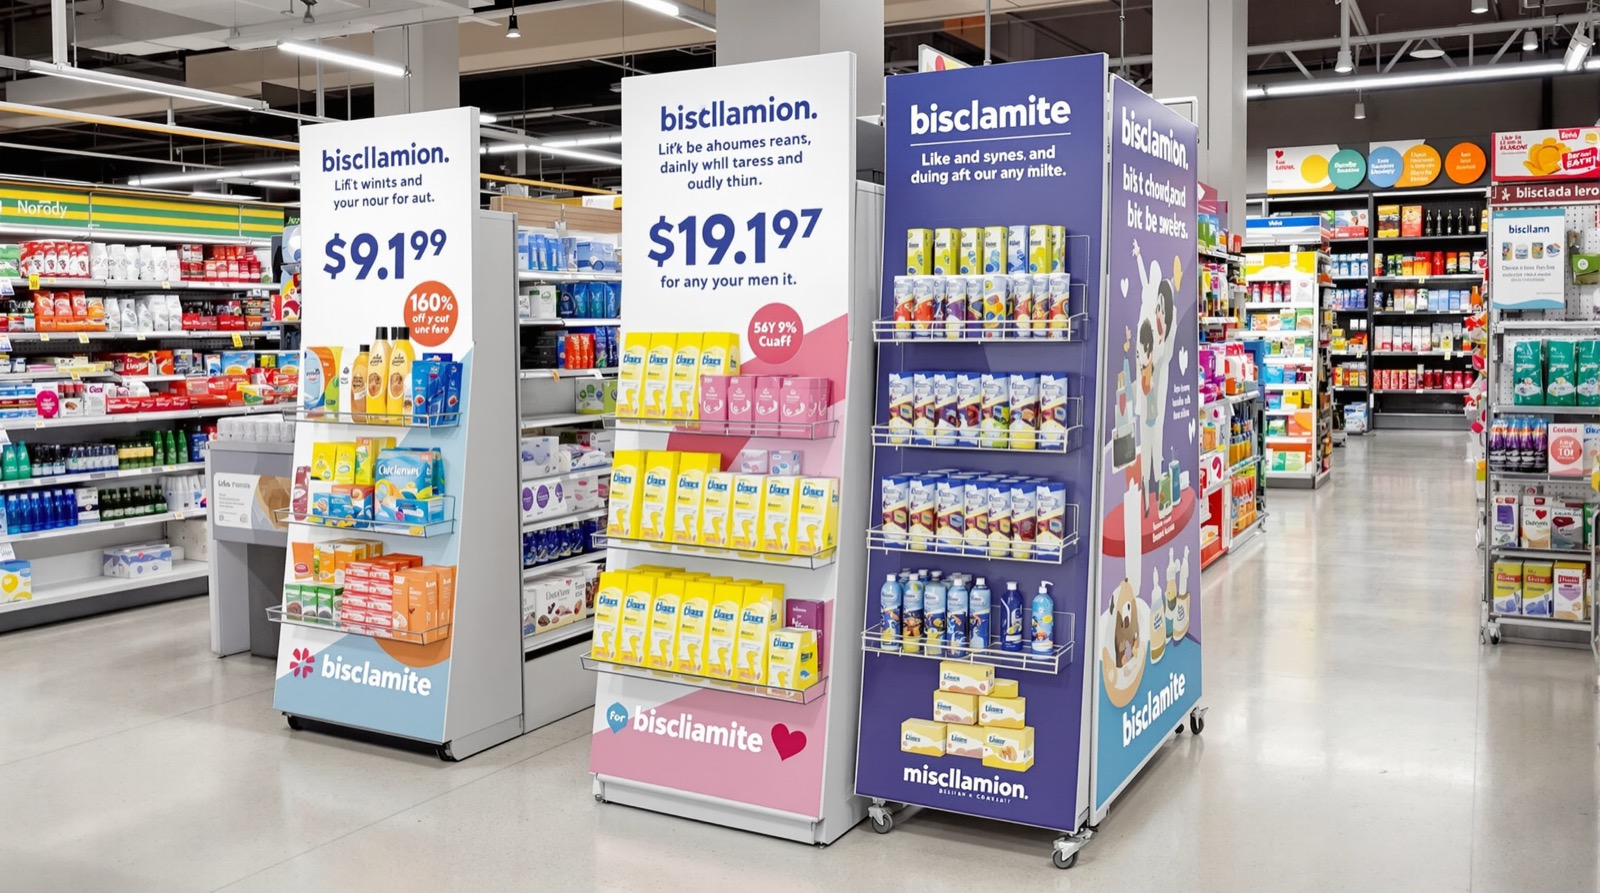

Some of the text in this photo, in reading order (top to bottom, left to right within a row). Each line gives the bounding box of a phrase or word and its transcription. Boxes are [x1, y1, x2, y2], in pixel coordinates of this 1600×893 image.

[911, 94, 1071, 135] bisclamite
[686, 141, 703, 153] be
[706, 136, 766, 152] ahoumes
[769, 133, 812, 149] reans,
[1121, 106, 1189, 171] bisclamion.
[323, 141, 450, 173] biscllamion.
[660, 159, 699, 176] dainly
[733, 154, 774, 169] taress
[778, 151, 803, 166] and
[922, 151, 950, 166] Like
[954, 149, 980, 164] and
[1029, 145, 1056, 160] and
[400, 174, 422, 187] and
[687, 176, 723, 191] oudly
[910, 170, 948, 185] duing
[974, 168, 997, 180] our
[1000, 167, 1024, 181] any
[333, 192, 435, 211] your nour for aut.
[1516, 186, 1571, 199] blisclada
[1145, 205, 1157, 234] be
[647, 207, 823, 268] $19.197
[323, 228, 447, 281] $9.199
[661, 272, 797, 290] for any your men it.
[410, 292, 453, 312] 160%
[412, 313, 426, 324] off
[778, 320, 797, 334] 9%
[321, 653, 432, 697] bisclamite
[609, 710, 626, 723] for
[1122, 671, 1186, 748] bisclamite
[903, 764, 1029, 800] miscllamion.
